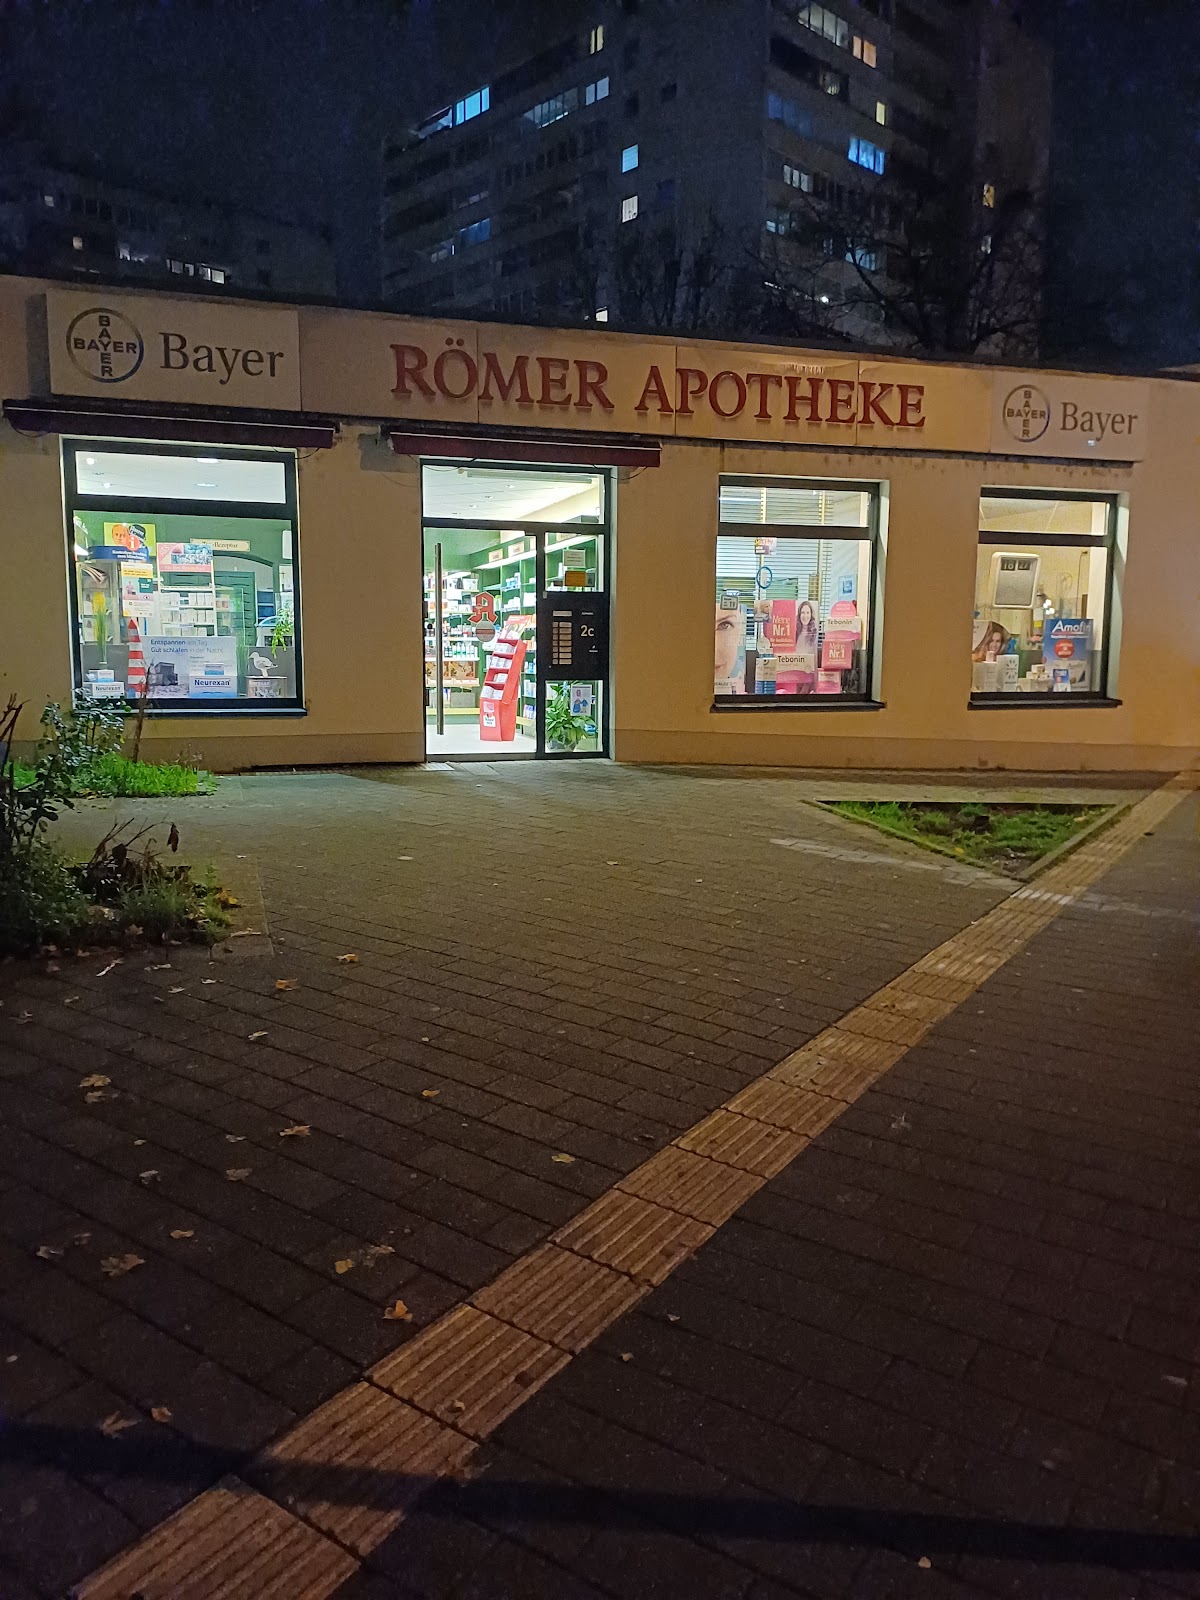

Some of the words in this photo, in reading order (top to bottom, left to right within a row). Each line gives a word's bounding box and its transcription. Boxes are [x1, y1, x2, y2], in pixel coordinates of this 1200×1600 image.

[73, 337, 137, 354] BAYER
[98, 315, 113, 378] BAYER
[158, 332, 284, 385] Bayer
[389, 337, 615, 409] RÖMER
[634, 365, 926, 428] APOTHEKE
[1006, 408, 1046, 420] BAYER
[1022, 390, 1032, 438] BAYER
[1060, 401, 1139, 442] Bayer
[150, 639, 186, 647] Entspannen
[580, 624, 594, 637] 2c
